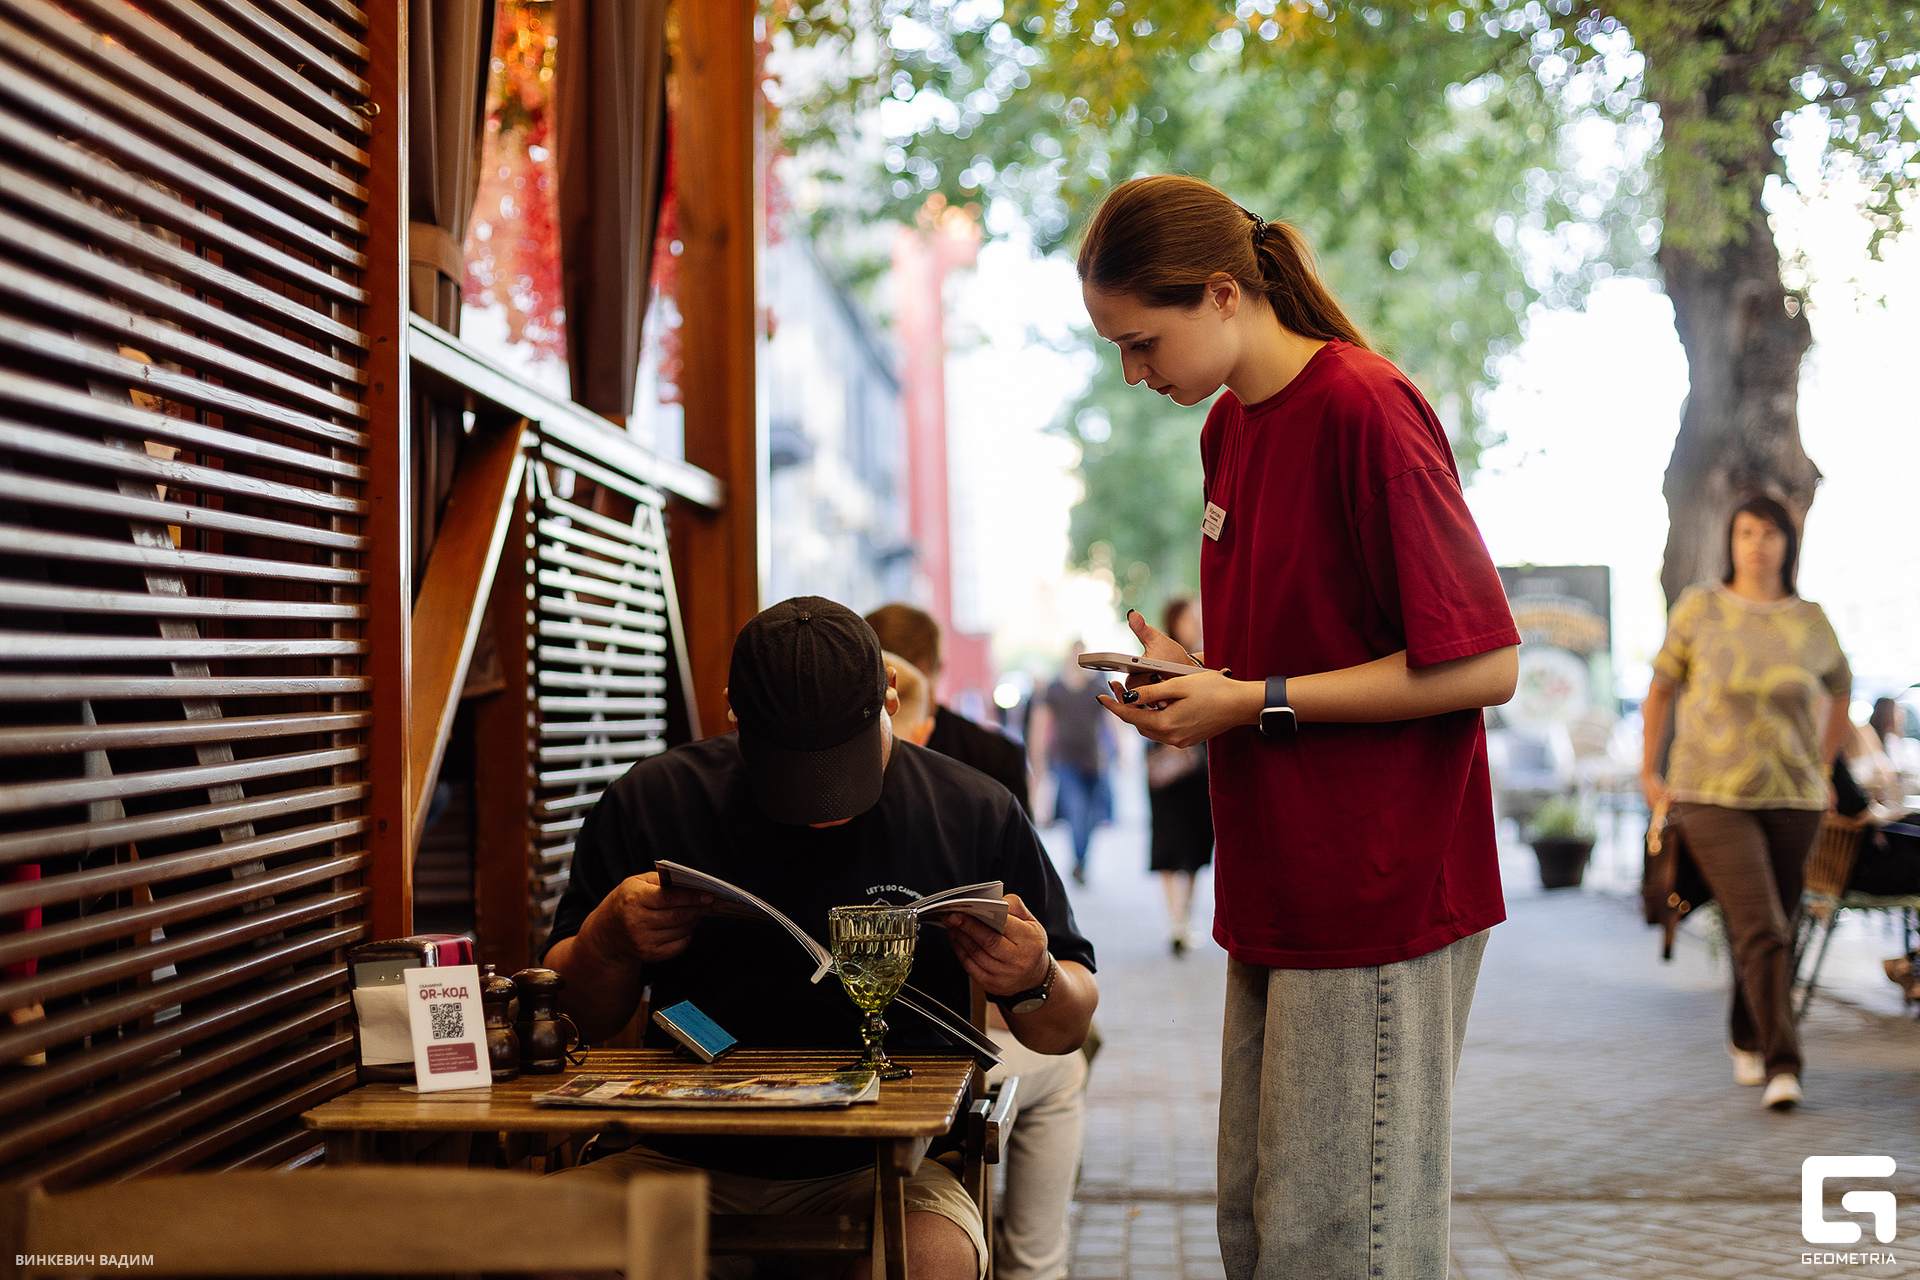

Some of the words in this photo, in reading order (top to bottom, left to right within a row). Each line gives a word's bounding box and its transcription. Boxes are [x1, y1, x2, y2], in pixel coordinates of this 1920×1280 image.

[866, 885, 885, 895] LET'S
[898, 885, 925, 900] CAMPIN
[419, 986, 469, 1000] QR-КОД
